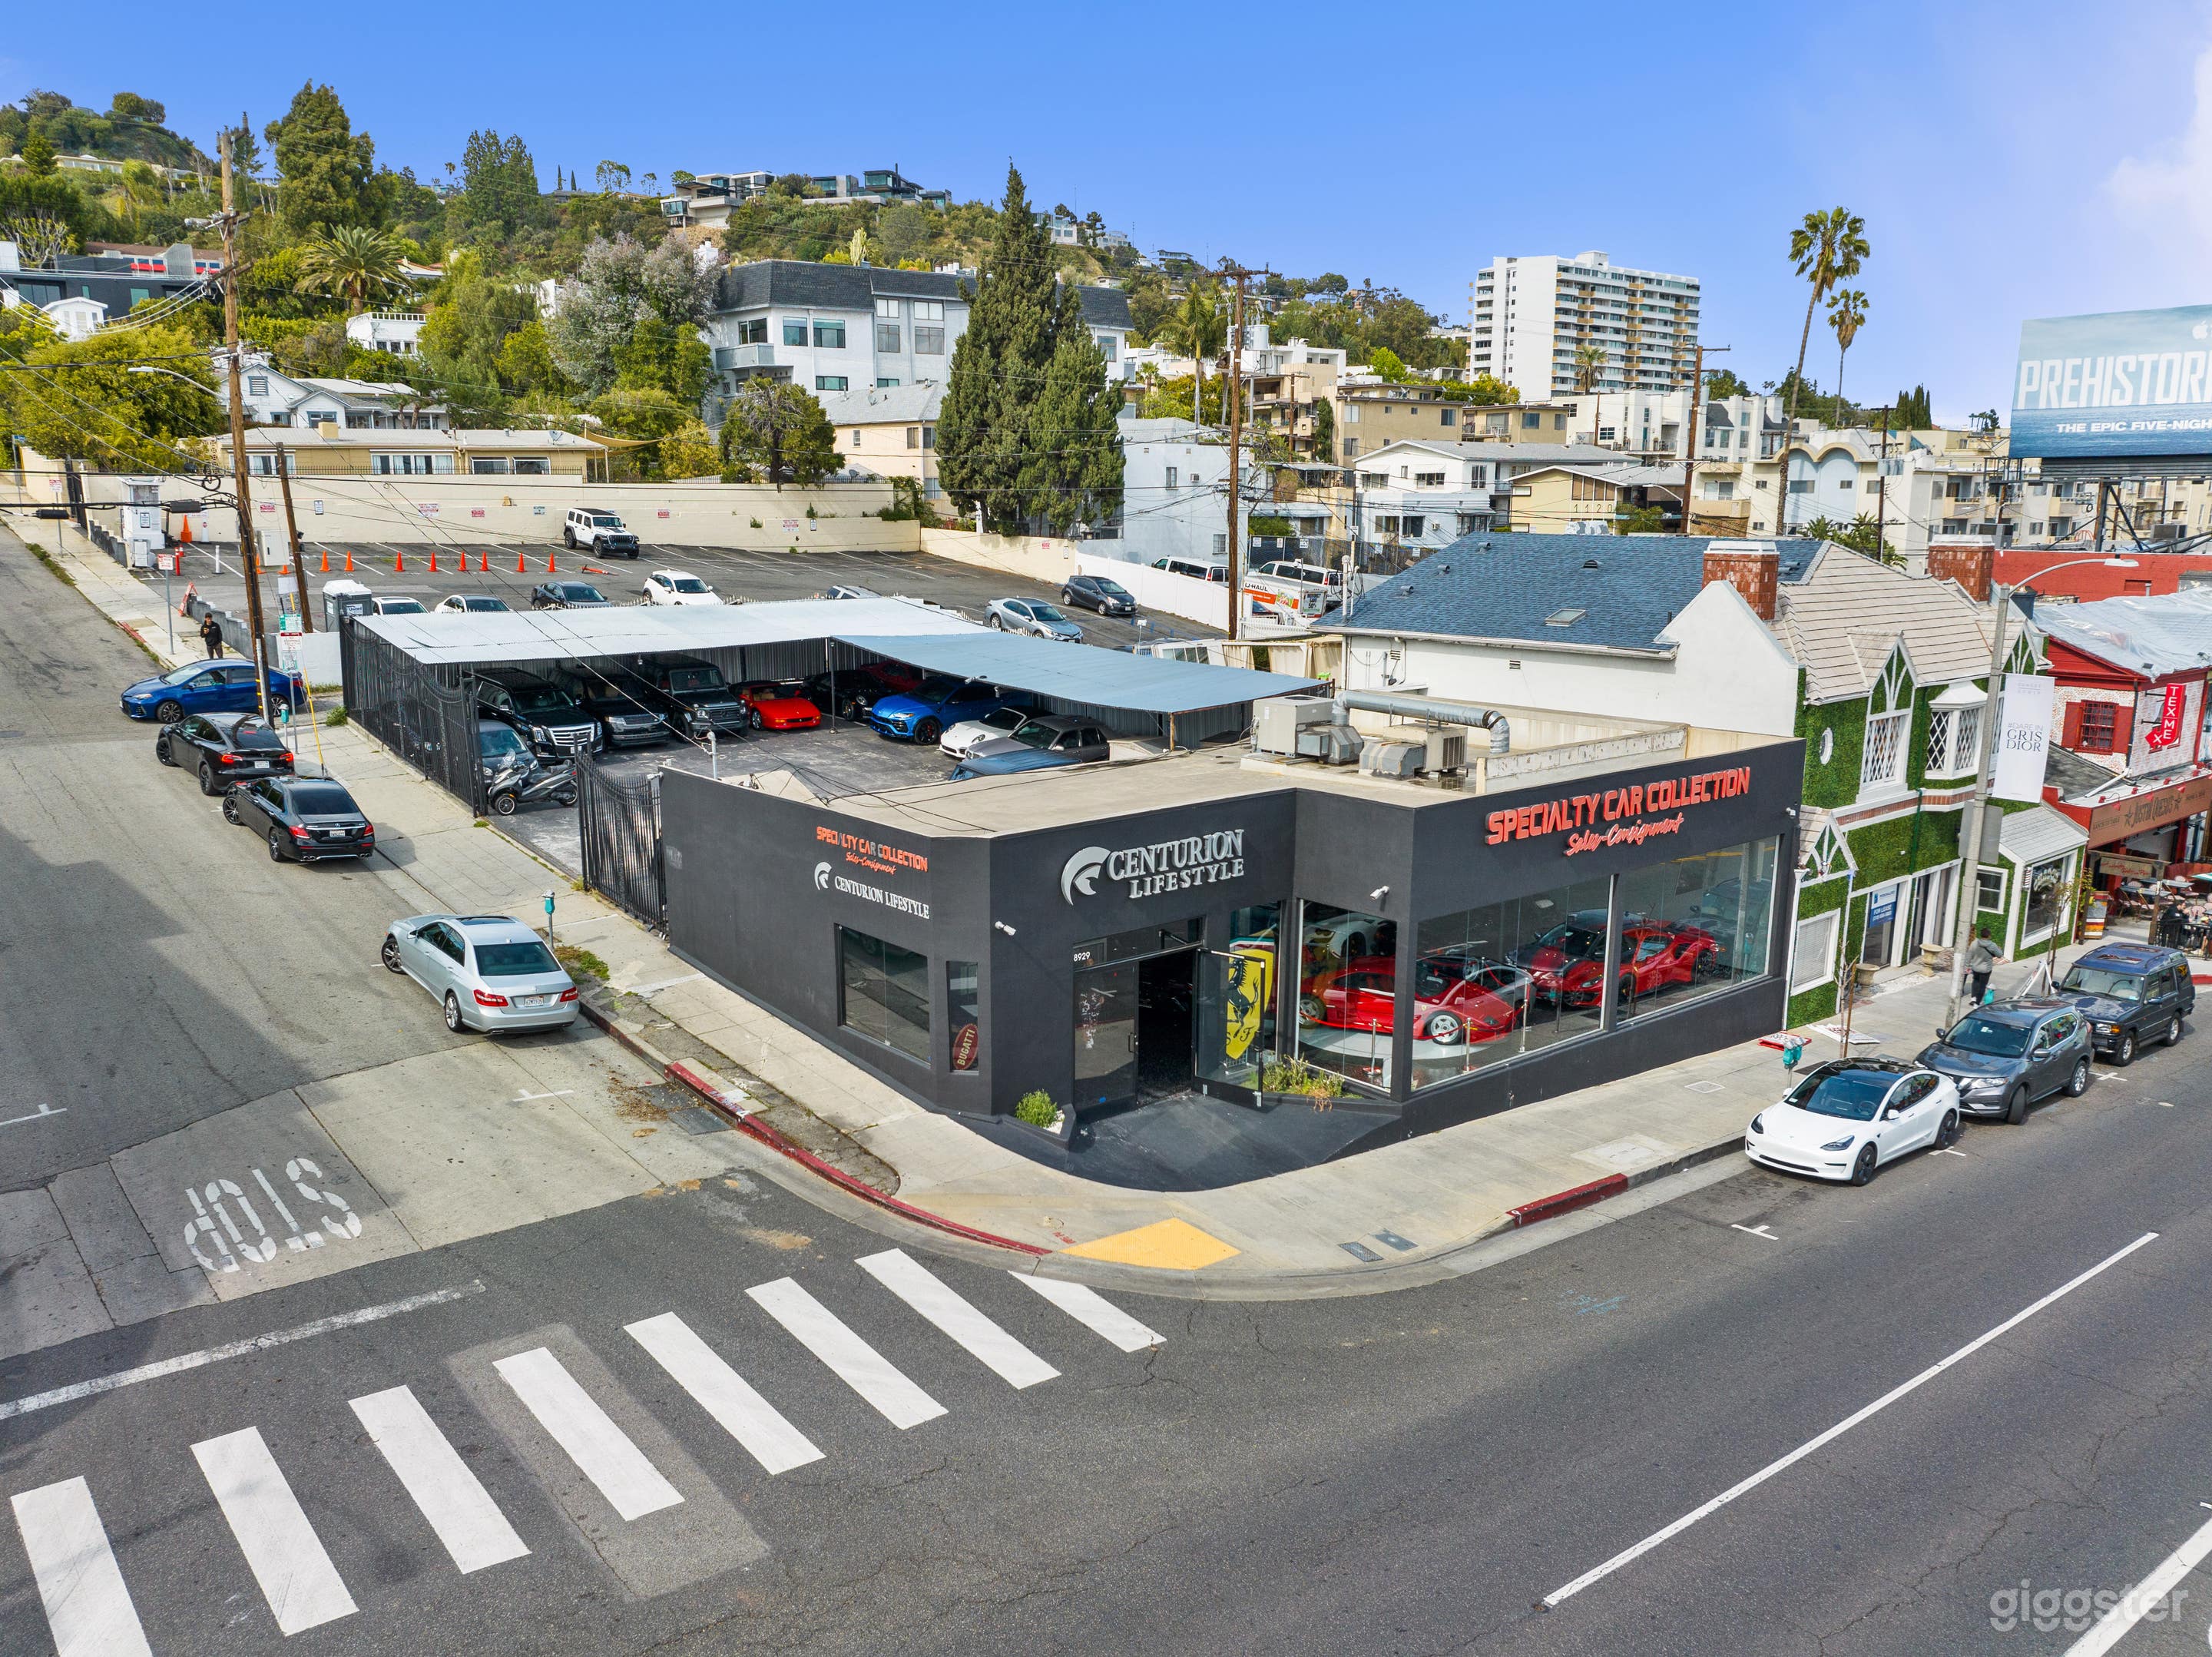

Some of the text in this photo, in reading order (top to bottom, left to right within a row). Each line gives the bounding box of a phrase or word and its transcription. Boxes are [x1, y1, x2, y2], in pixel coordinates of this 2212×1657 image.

[2056, 423, 2087, 433] THE
[2091, 422, 2127, 432] EPIC
[1244, 582, 1268, 592] U-HAUL
[2166, 686, 2180, 717] TEX
[2006, 739, 2041, 752] DIOR
[2007, 728, 2043, 742] GRIS
[1485, 767, 1750, 845] SPECIALTY CAR COLLECTION
[816, 826, 928, 873] SPECIALTY CAR COLLECTION
[1106, 829, 1244, 881] CENTURION
[1129, 858, 1245, 899] LIFESTYLE
[834, 876, 929, 920] CENTURION LIFESTYLE
[1074, 951, 1091, 962] 8929
[957, 1029, 975, 1065] BUGATTI
[184, 1157, 363, 1274] STOP
